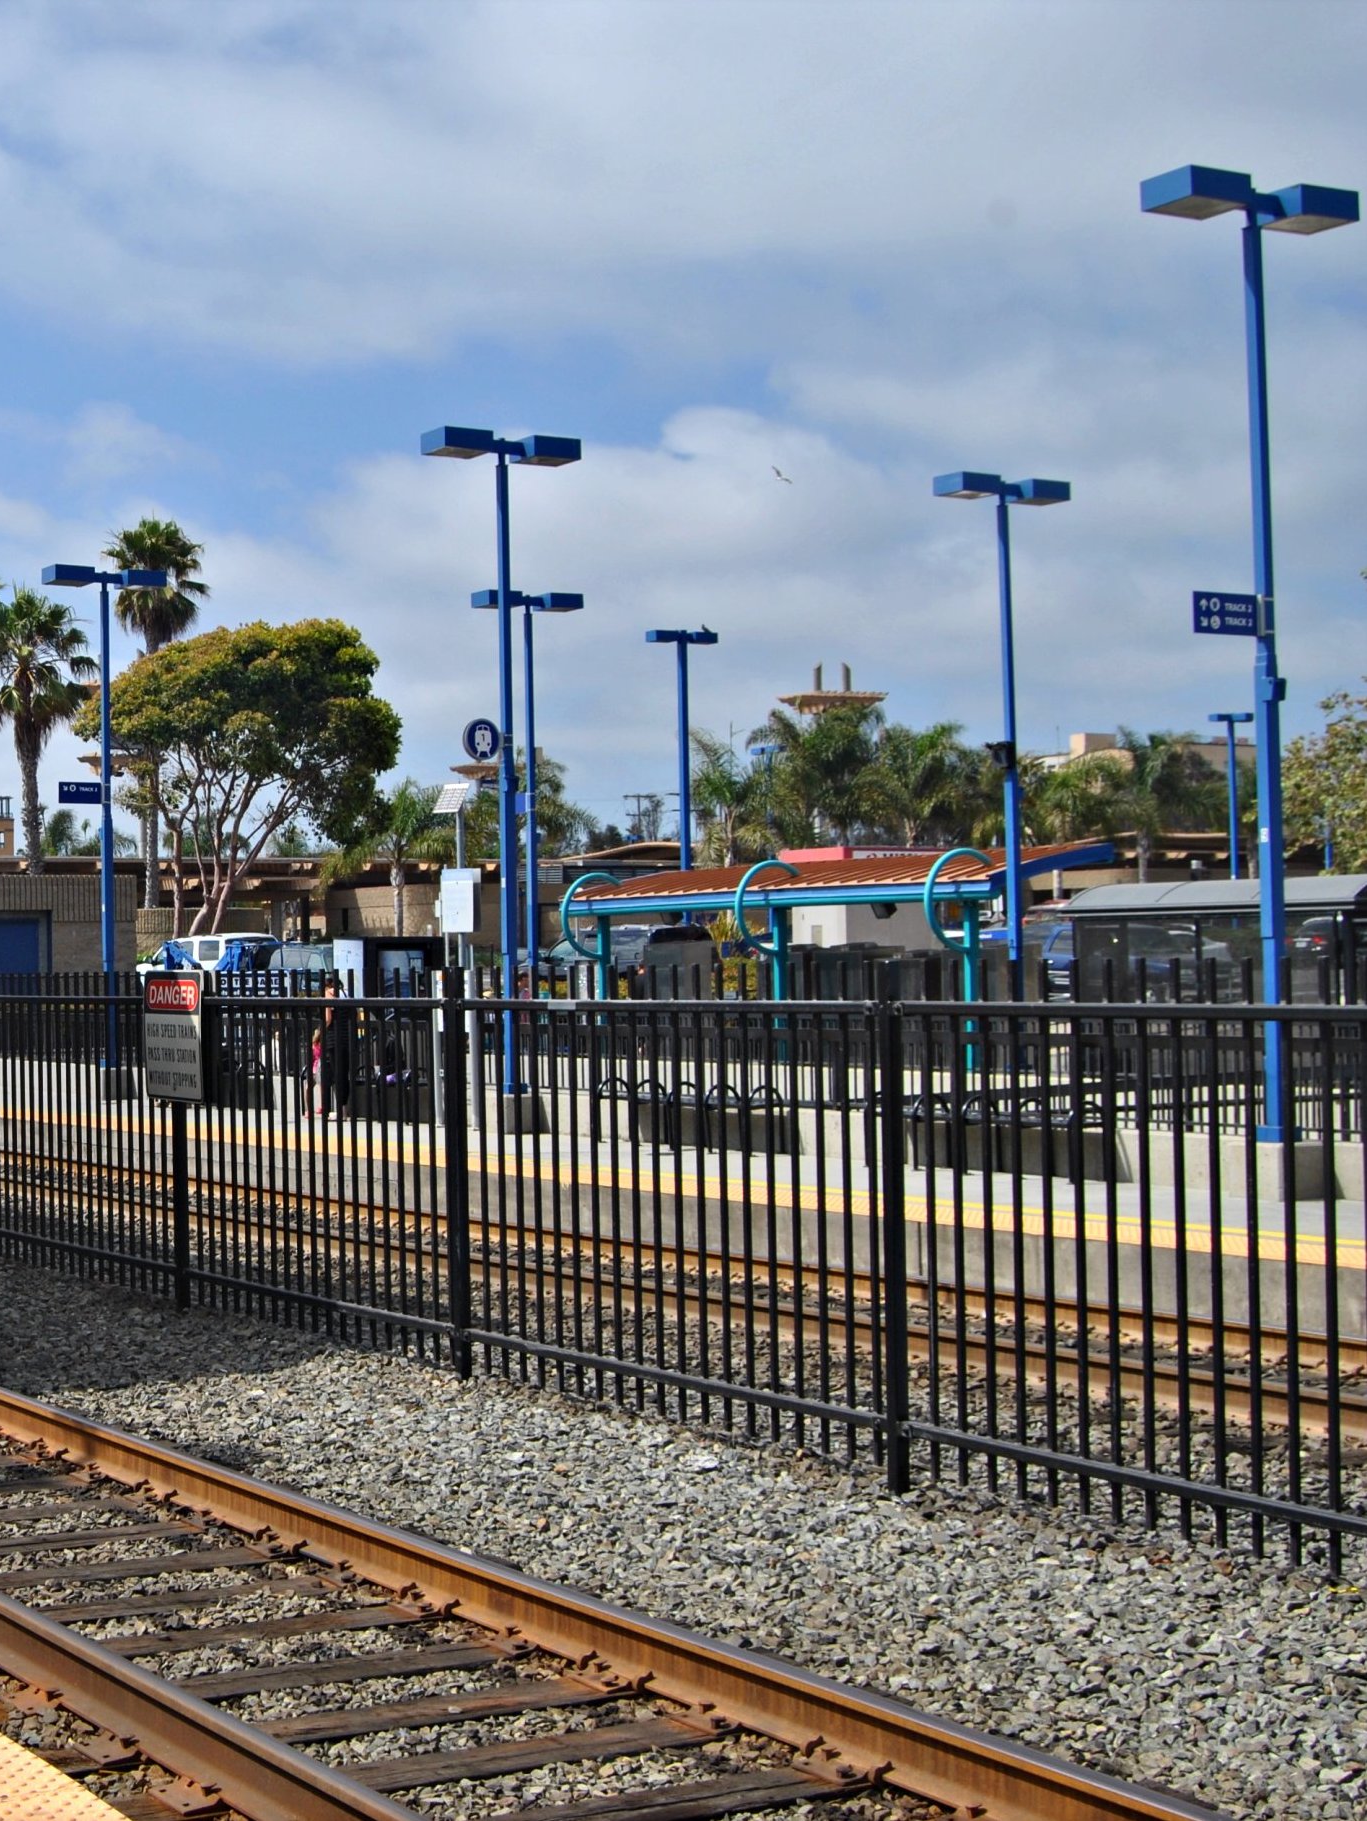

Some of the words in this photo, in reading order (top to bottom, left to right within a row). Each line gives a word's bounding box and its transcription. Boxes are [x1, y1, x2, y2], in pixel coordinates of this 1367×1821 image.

[1224, 602, 1247, 613] TRACK
[1224, 616, 1247, 626] TRACK
[148, 985, 195, 1006] DANGER
[147, 1023, 160, 1038] HIGH
[160, 1023, 177, 1039] SPEED
[178, 1024, 197, 1040] TRAINS
[147, 1046, 160, 1062] PASS
[161, 1047, 175, 1063] THRU
[177, 1048, 197, 1065] STATION
[149, 1070, 171, 1086] WITHOUT
[172, 1072, 197, 1089] STOPPING
